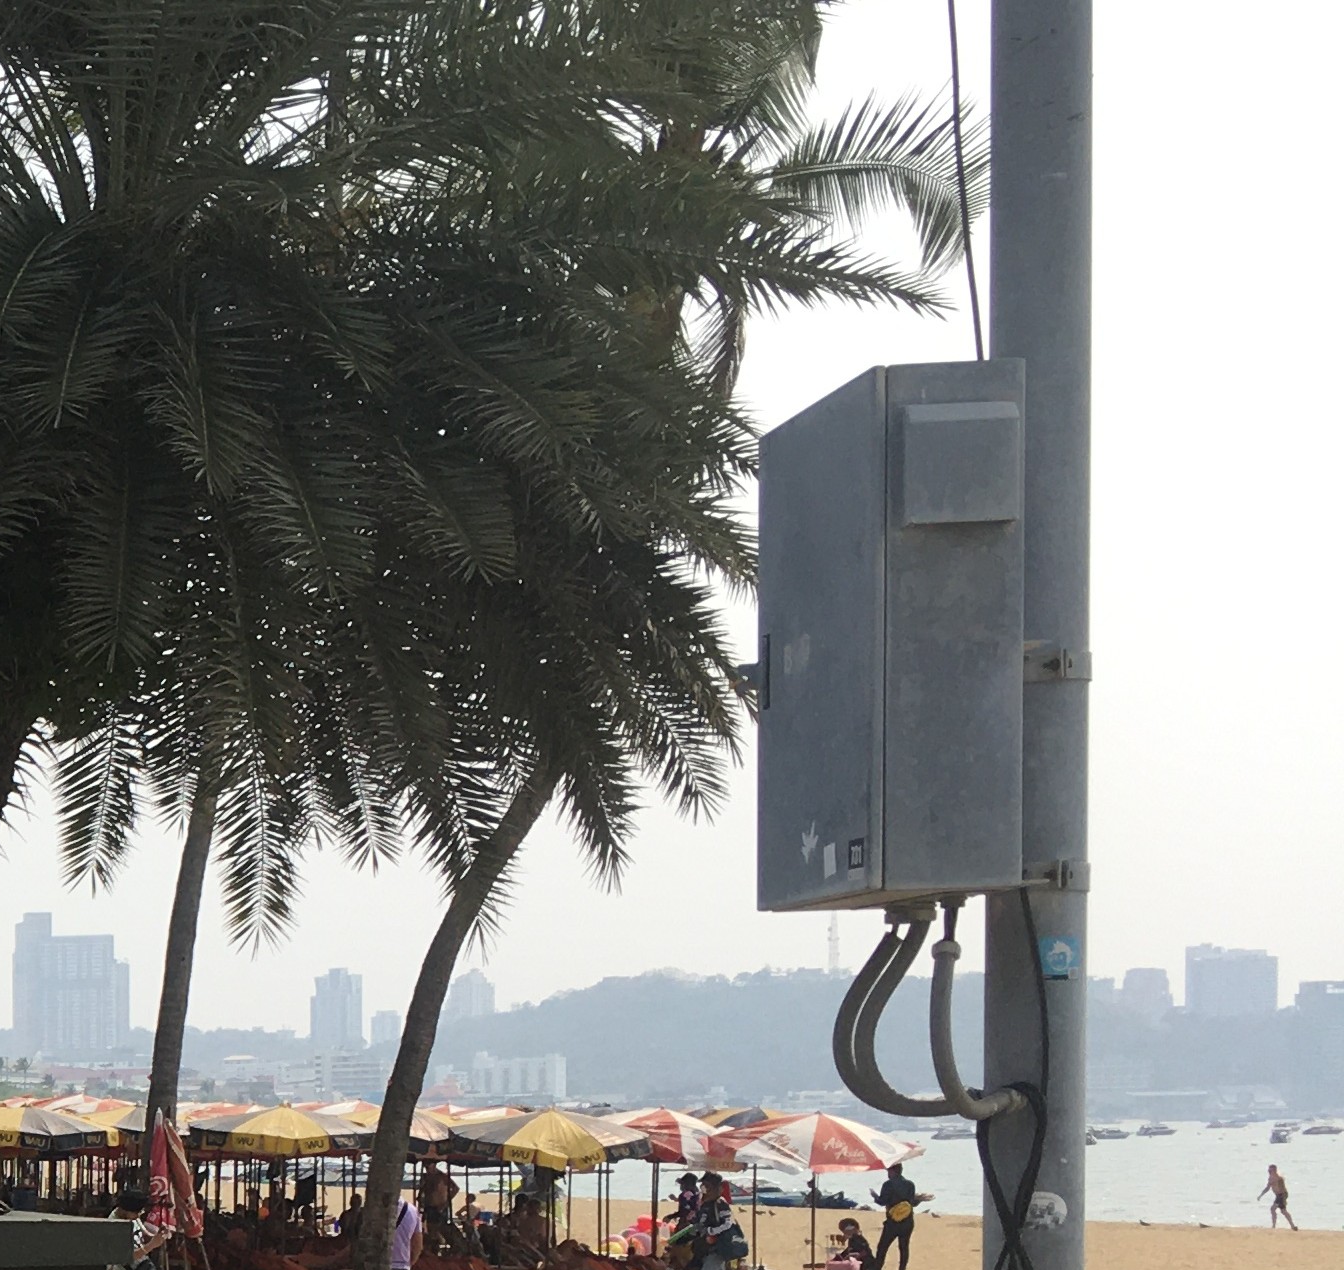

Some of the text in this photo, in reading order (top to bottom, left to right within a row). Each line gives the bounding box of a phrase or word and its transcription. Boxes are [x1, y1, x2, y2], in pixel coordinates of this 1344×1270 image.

[238, 1137, 254, 1146] WU
[306, 1140, 324, 1149] WU
[511, 1149, 530, 1159] WU
[580, 1152, 600, 1164] WU
